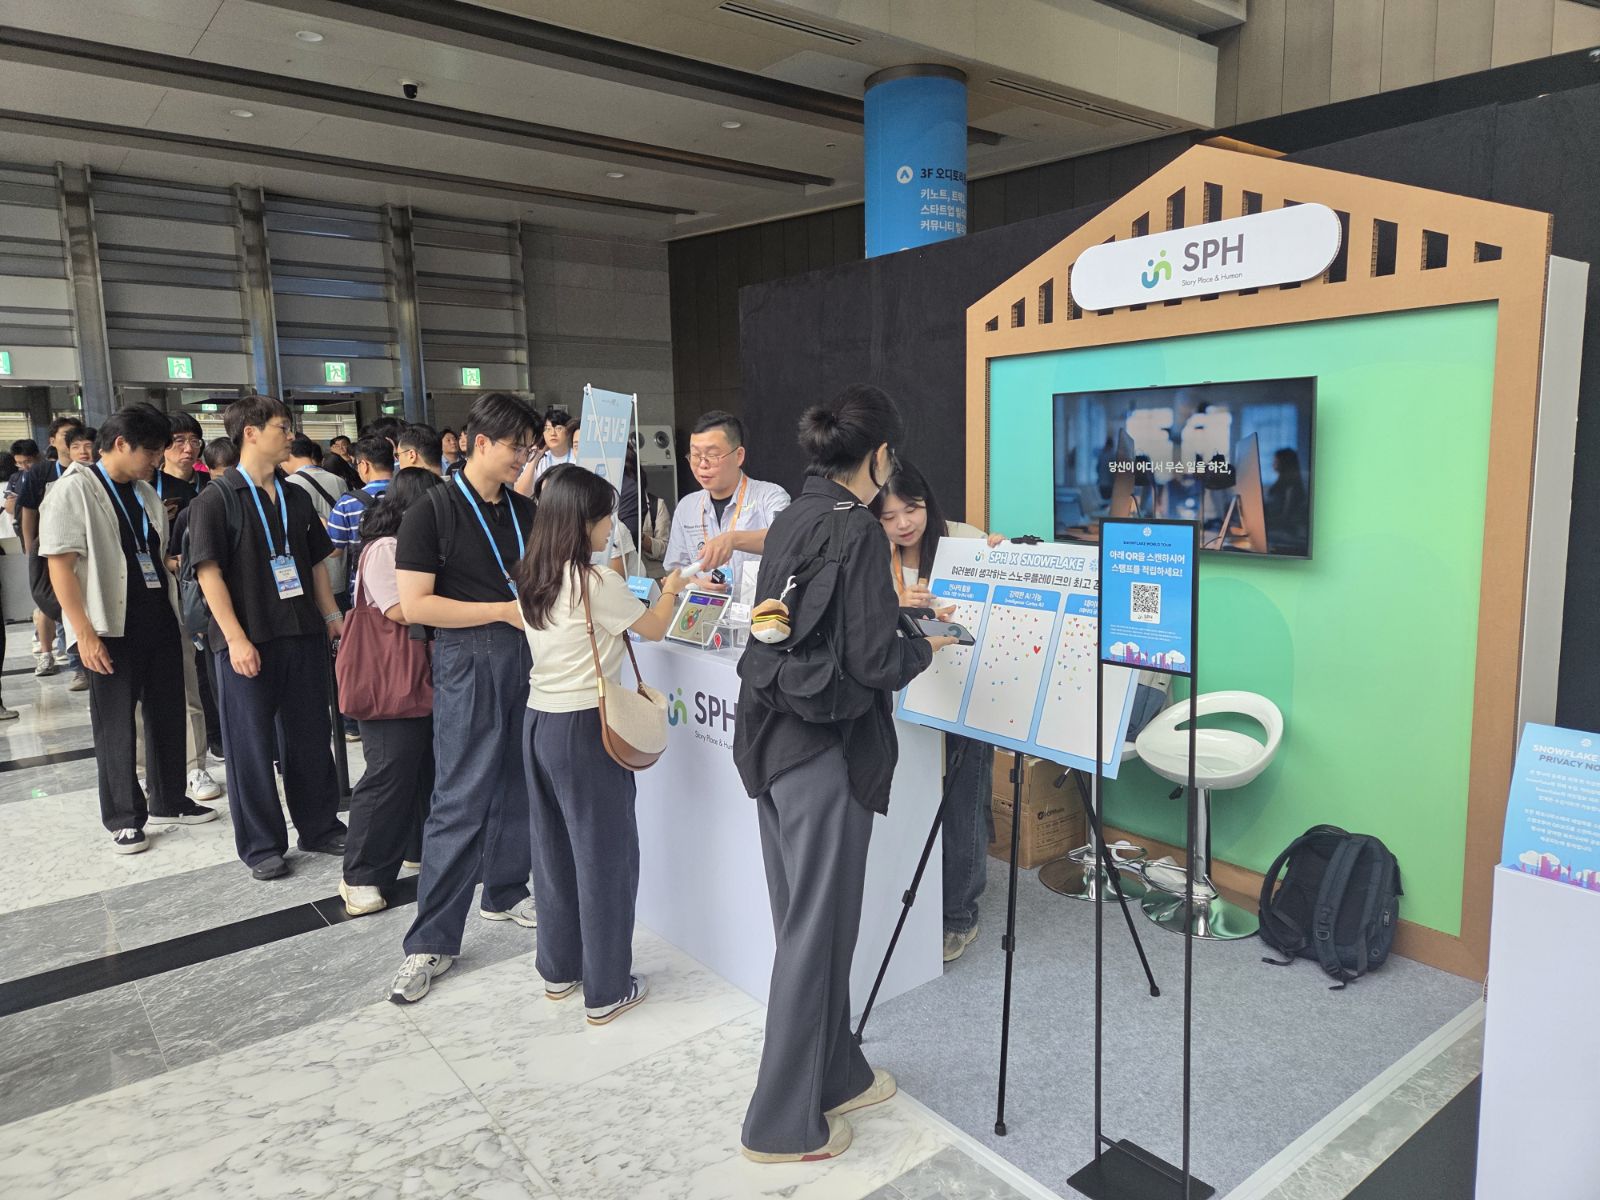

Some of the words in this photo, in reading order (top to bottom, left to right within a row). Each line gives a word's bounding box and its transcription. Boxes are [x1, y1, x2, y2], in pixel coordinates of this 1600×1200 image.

[920, 168, 934, 179] 3F
[921, 188, 950, 202] 키노트,
[921, 205, 954, 217] 스타트업
[921, 220, 954, 232] 커뮤니티
[1182, 233, 1244, 272] SPH
[1182, 279, 1197, 287] Story
[1108, 461, 1135, 474] 당신이
[1136, 461, 1163, 474] 어디서
[1165, 461, 1184, 473] 무슨
[1186, 461, 1206, 474] 일을
[1207, 460, 1232, 475] 하건,
[988, 550, 1008, 564] SPH
[1009, 552, 1019, 565] X
[1020, 552, 1086, 571] SNOWFLAKE
[1109, 549, 1124, 560] 아래
[1125, 551, 1145, 562] QR을
[1146, 553, 1185, 565] 스캔하시어
[1111, 563, 1140, 575] 스탬프를
[1142, 566, 1183, 577] 적립하세요!
[978, 566, 1007, 581] 생각하는
[1008, 571, 1072, 587] 스노우플레이크의
[1073, 577, 1091, 590] 최고
[694, 691, 739, 732] SPH
[695, 730, 706, 742] Story
[706, 734, 718, 745] Place
[1532, 744, 1599, 762] SNOWFLAKE
[1539, 754, 1584, 769] PRIVACY
